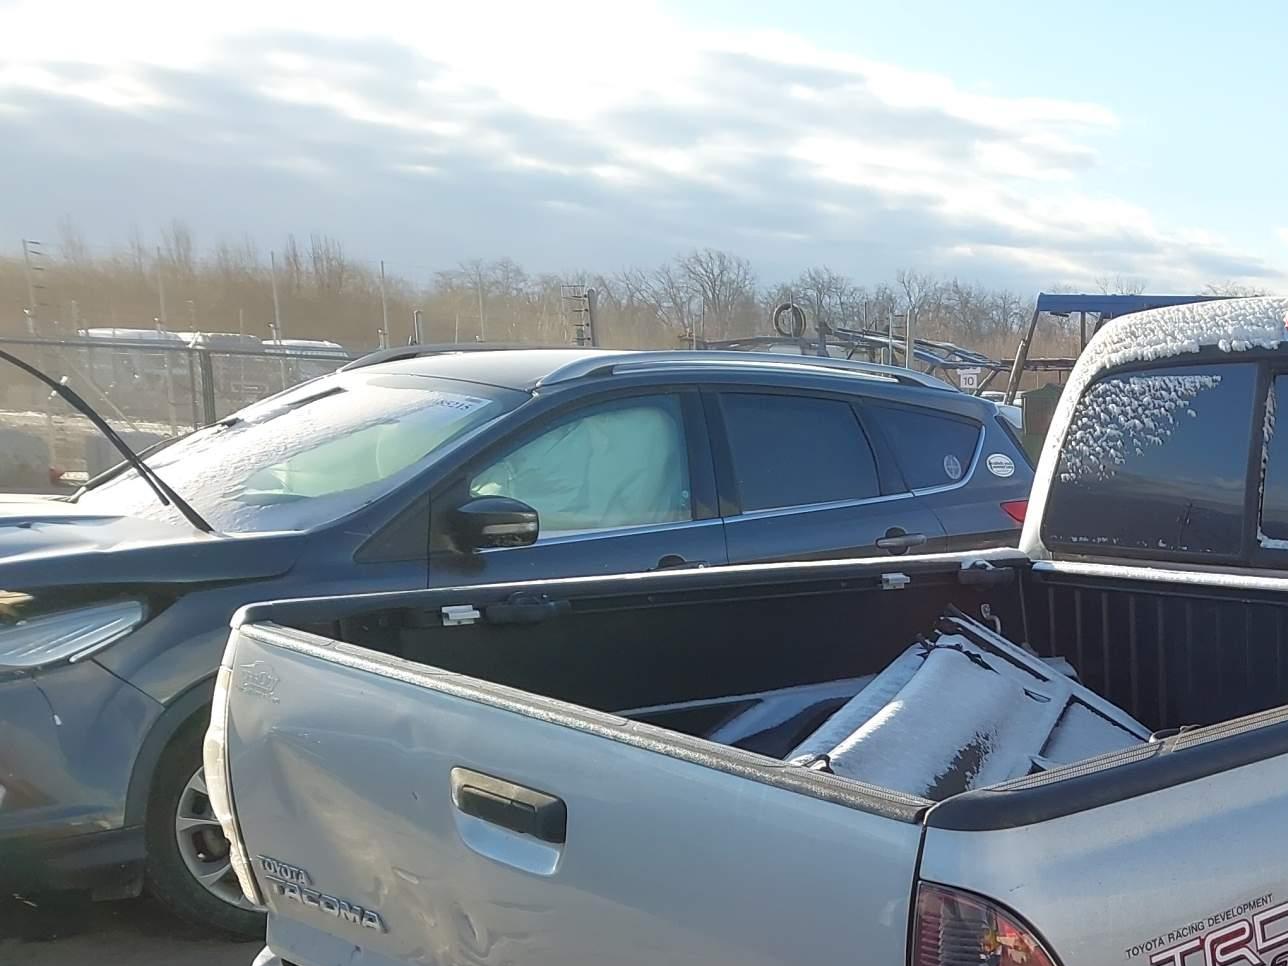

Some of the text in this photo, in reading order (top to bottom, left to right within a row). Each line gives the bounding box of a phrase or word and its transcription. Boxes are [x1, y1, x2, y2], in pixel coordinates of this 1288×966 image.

[962, 376, 975, 386] 10
[257, 854, 313, 886] TOYOTA
[265, 875, 388, 934] TACOMA
[1125, 893, 1274, 960] TOYOTA RACING DEVELOPMENT
